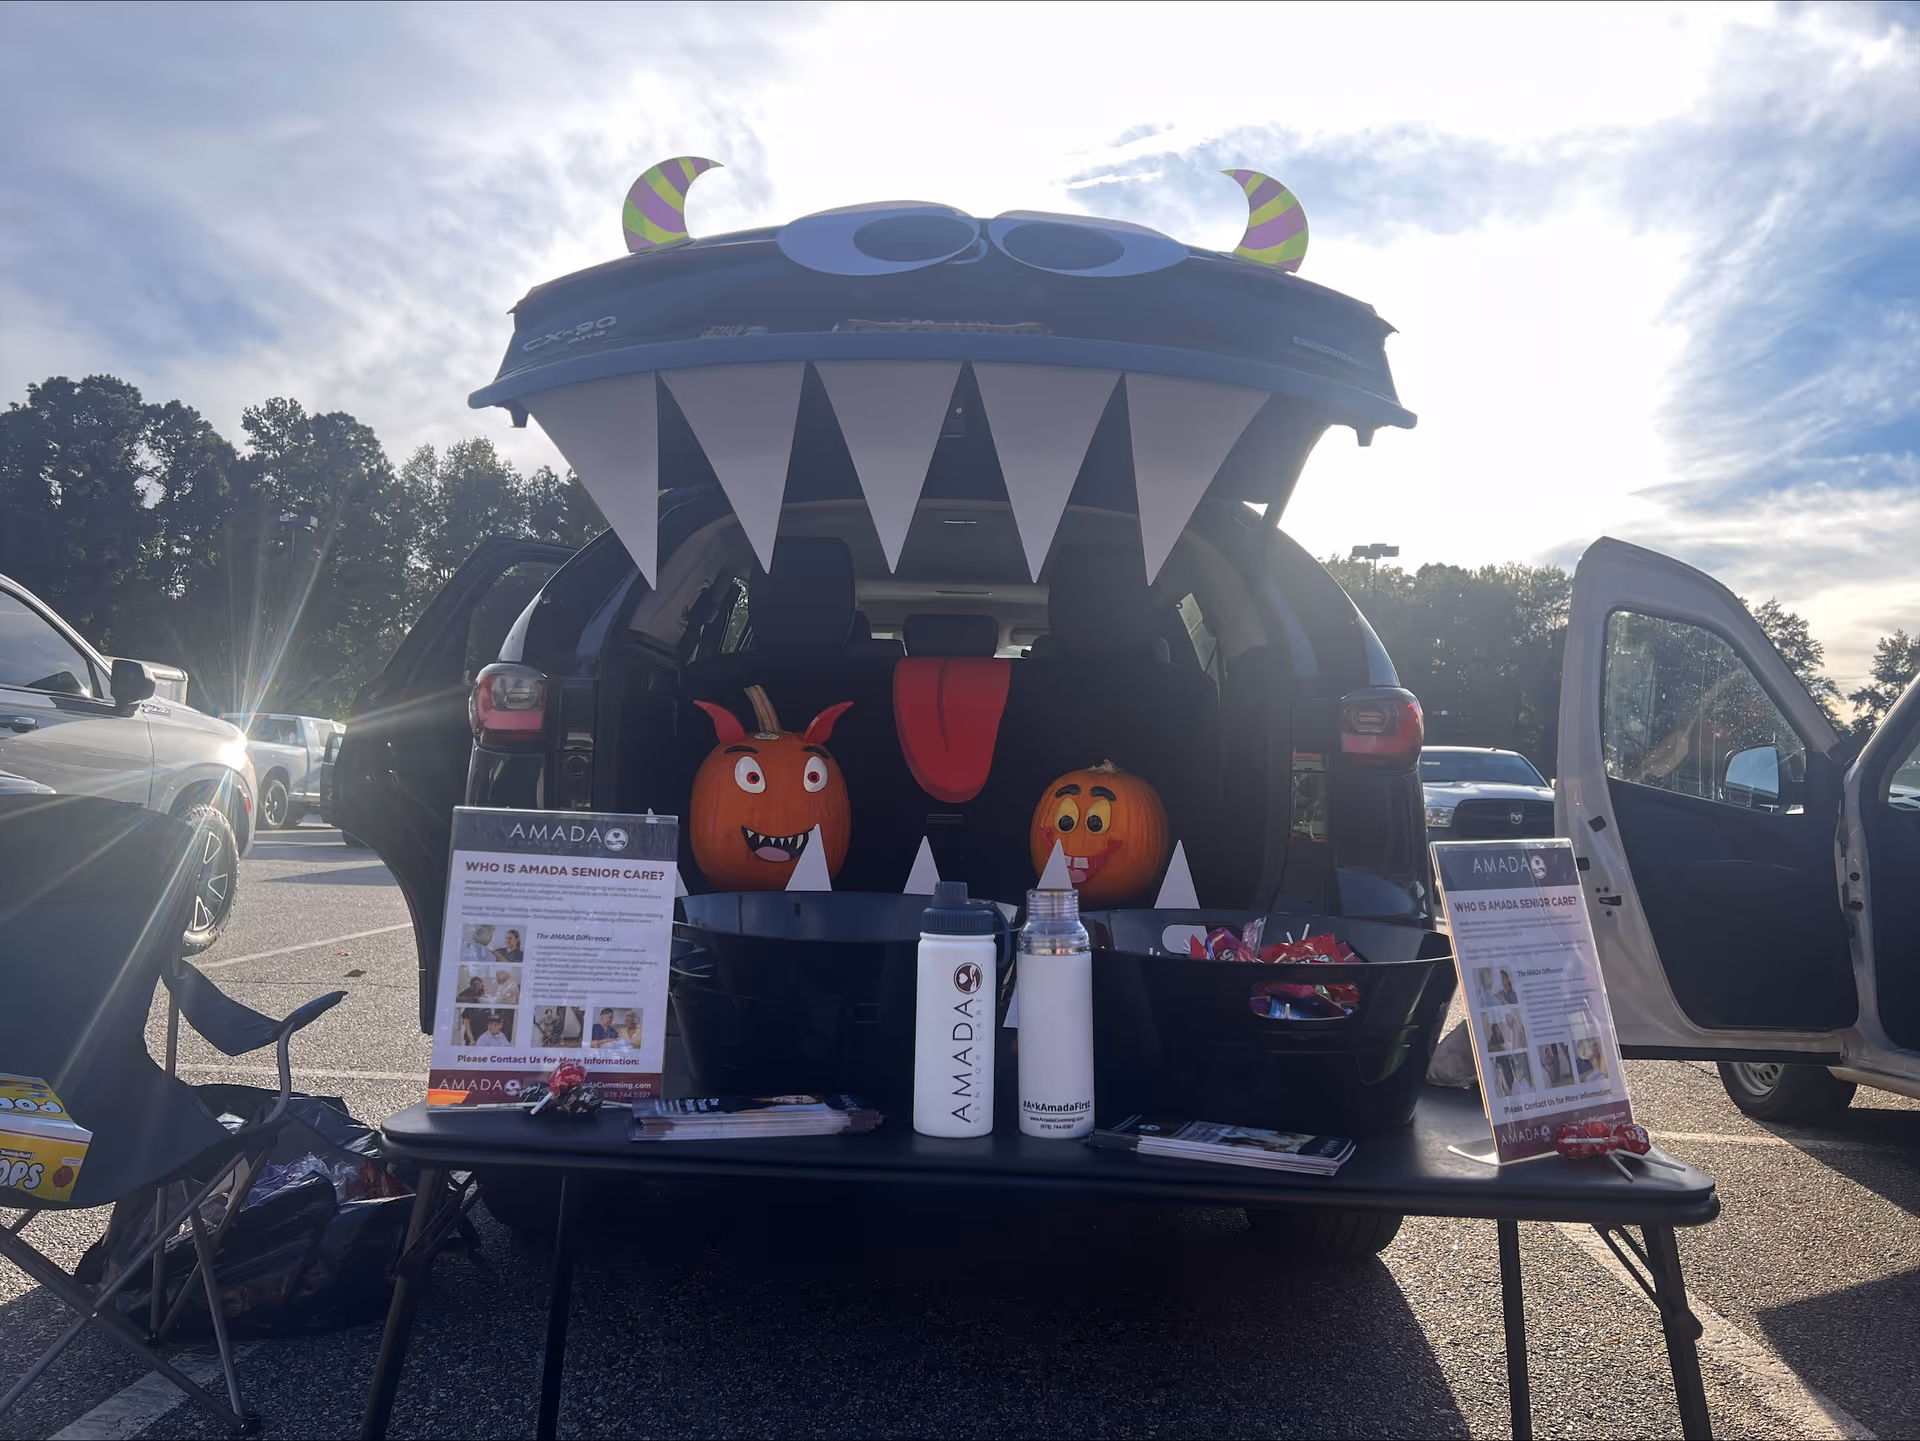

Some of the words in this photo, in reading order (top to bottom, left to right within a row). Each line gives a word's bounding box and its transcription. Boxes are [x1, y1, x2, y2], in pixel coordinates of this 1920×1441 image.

[509, 822, 602, 843] AMADA
[465, 861, 500, 873] WHO
[503, 863, 515, 874] IS
[519, 864, 568, 876] AMADA
[572, 867, 620, 878] SENIOR
[623, 869, 665, 881] CARE?
[1473, 856, 1531, 873] AMADA
[1454, 901, 1477, 913] WHO
[1478, 901, 1487, 911] IS
[1488, 899, 1519, 911] AMADA
[1520, 898, 1550, 909] SENIOR
[1551, 896, 1577, 907] CARE?
[549, 933, 575, 941] AMADA
[576, 934, 614, 942] Difference:
[457, 1054, 488, 1064] Please
[490, 1055, 527, 1065] Contact
[529, 1056, 542, 1064] Us
[543, 1055, 557, 1065] for
[558, 1056, 583, 1066] More
[584, 1056, 640, 1066] Information:
[951, 998, 974, 1123] AMADA
[438, 1078, 502, 1091] AMADA
[1504, 1105, 1523, 1115] Please
[1524, 1101, 1547, 1111] Contact
[1548, 1099, 1556, 1107] Us
[1556, 1097, 1565, 1105] for
[1565, 1094, 1579, 1103] More
[1501, 1129, 1541, 1146] AMADA
